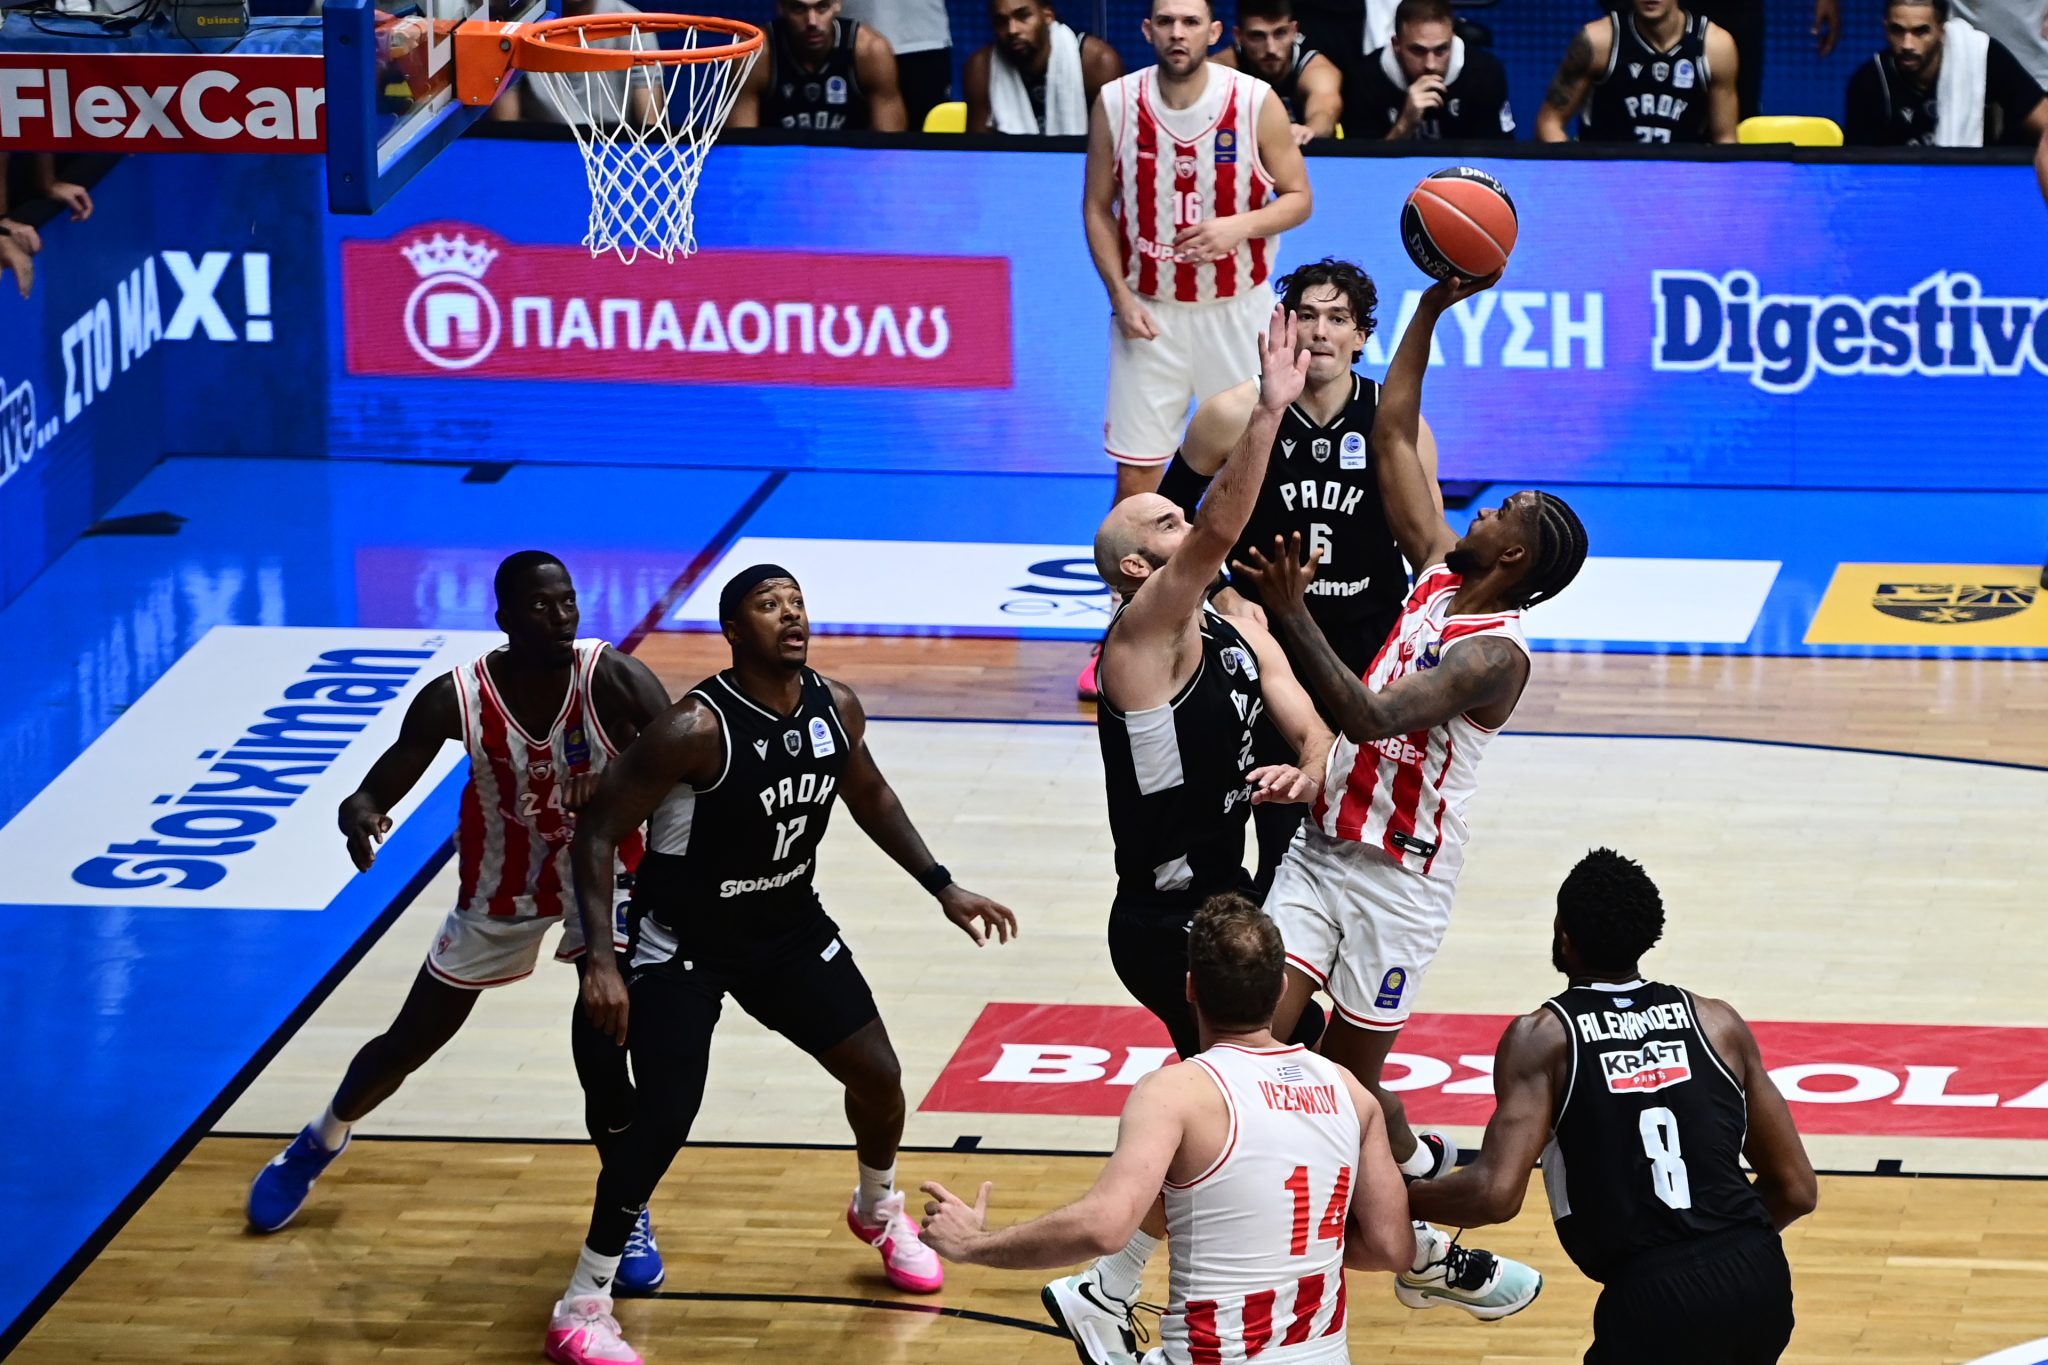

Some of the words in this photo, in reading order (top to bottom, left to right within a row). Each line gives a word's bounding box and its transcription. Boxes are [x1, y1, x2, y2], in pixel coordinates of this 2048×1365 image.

[0, 68, 325, 140] FlexCar
[1624, 93, 1689, 121] PAOK
[1170, 190, 1202, 225] 16
[1279, 479, 1365, 516] PAOK
[1310, 522, 1334, 565] 6
[71, 648, 437, 891] Stoiximan
[759, 773, 836, 817] PAOK
[772, 814, 809, 862] 17
[1576, 1002, 1691, 1043] ALEXANDER
[1604, 1044, 1683, 1076] KRAFT
[1638, 1106, 1692, 1210] 8
[1284, 1165, 1352, 1256] 14
